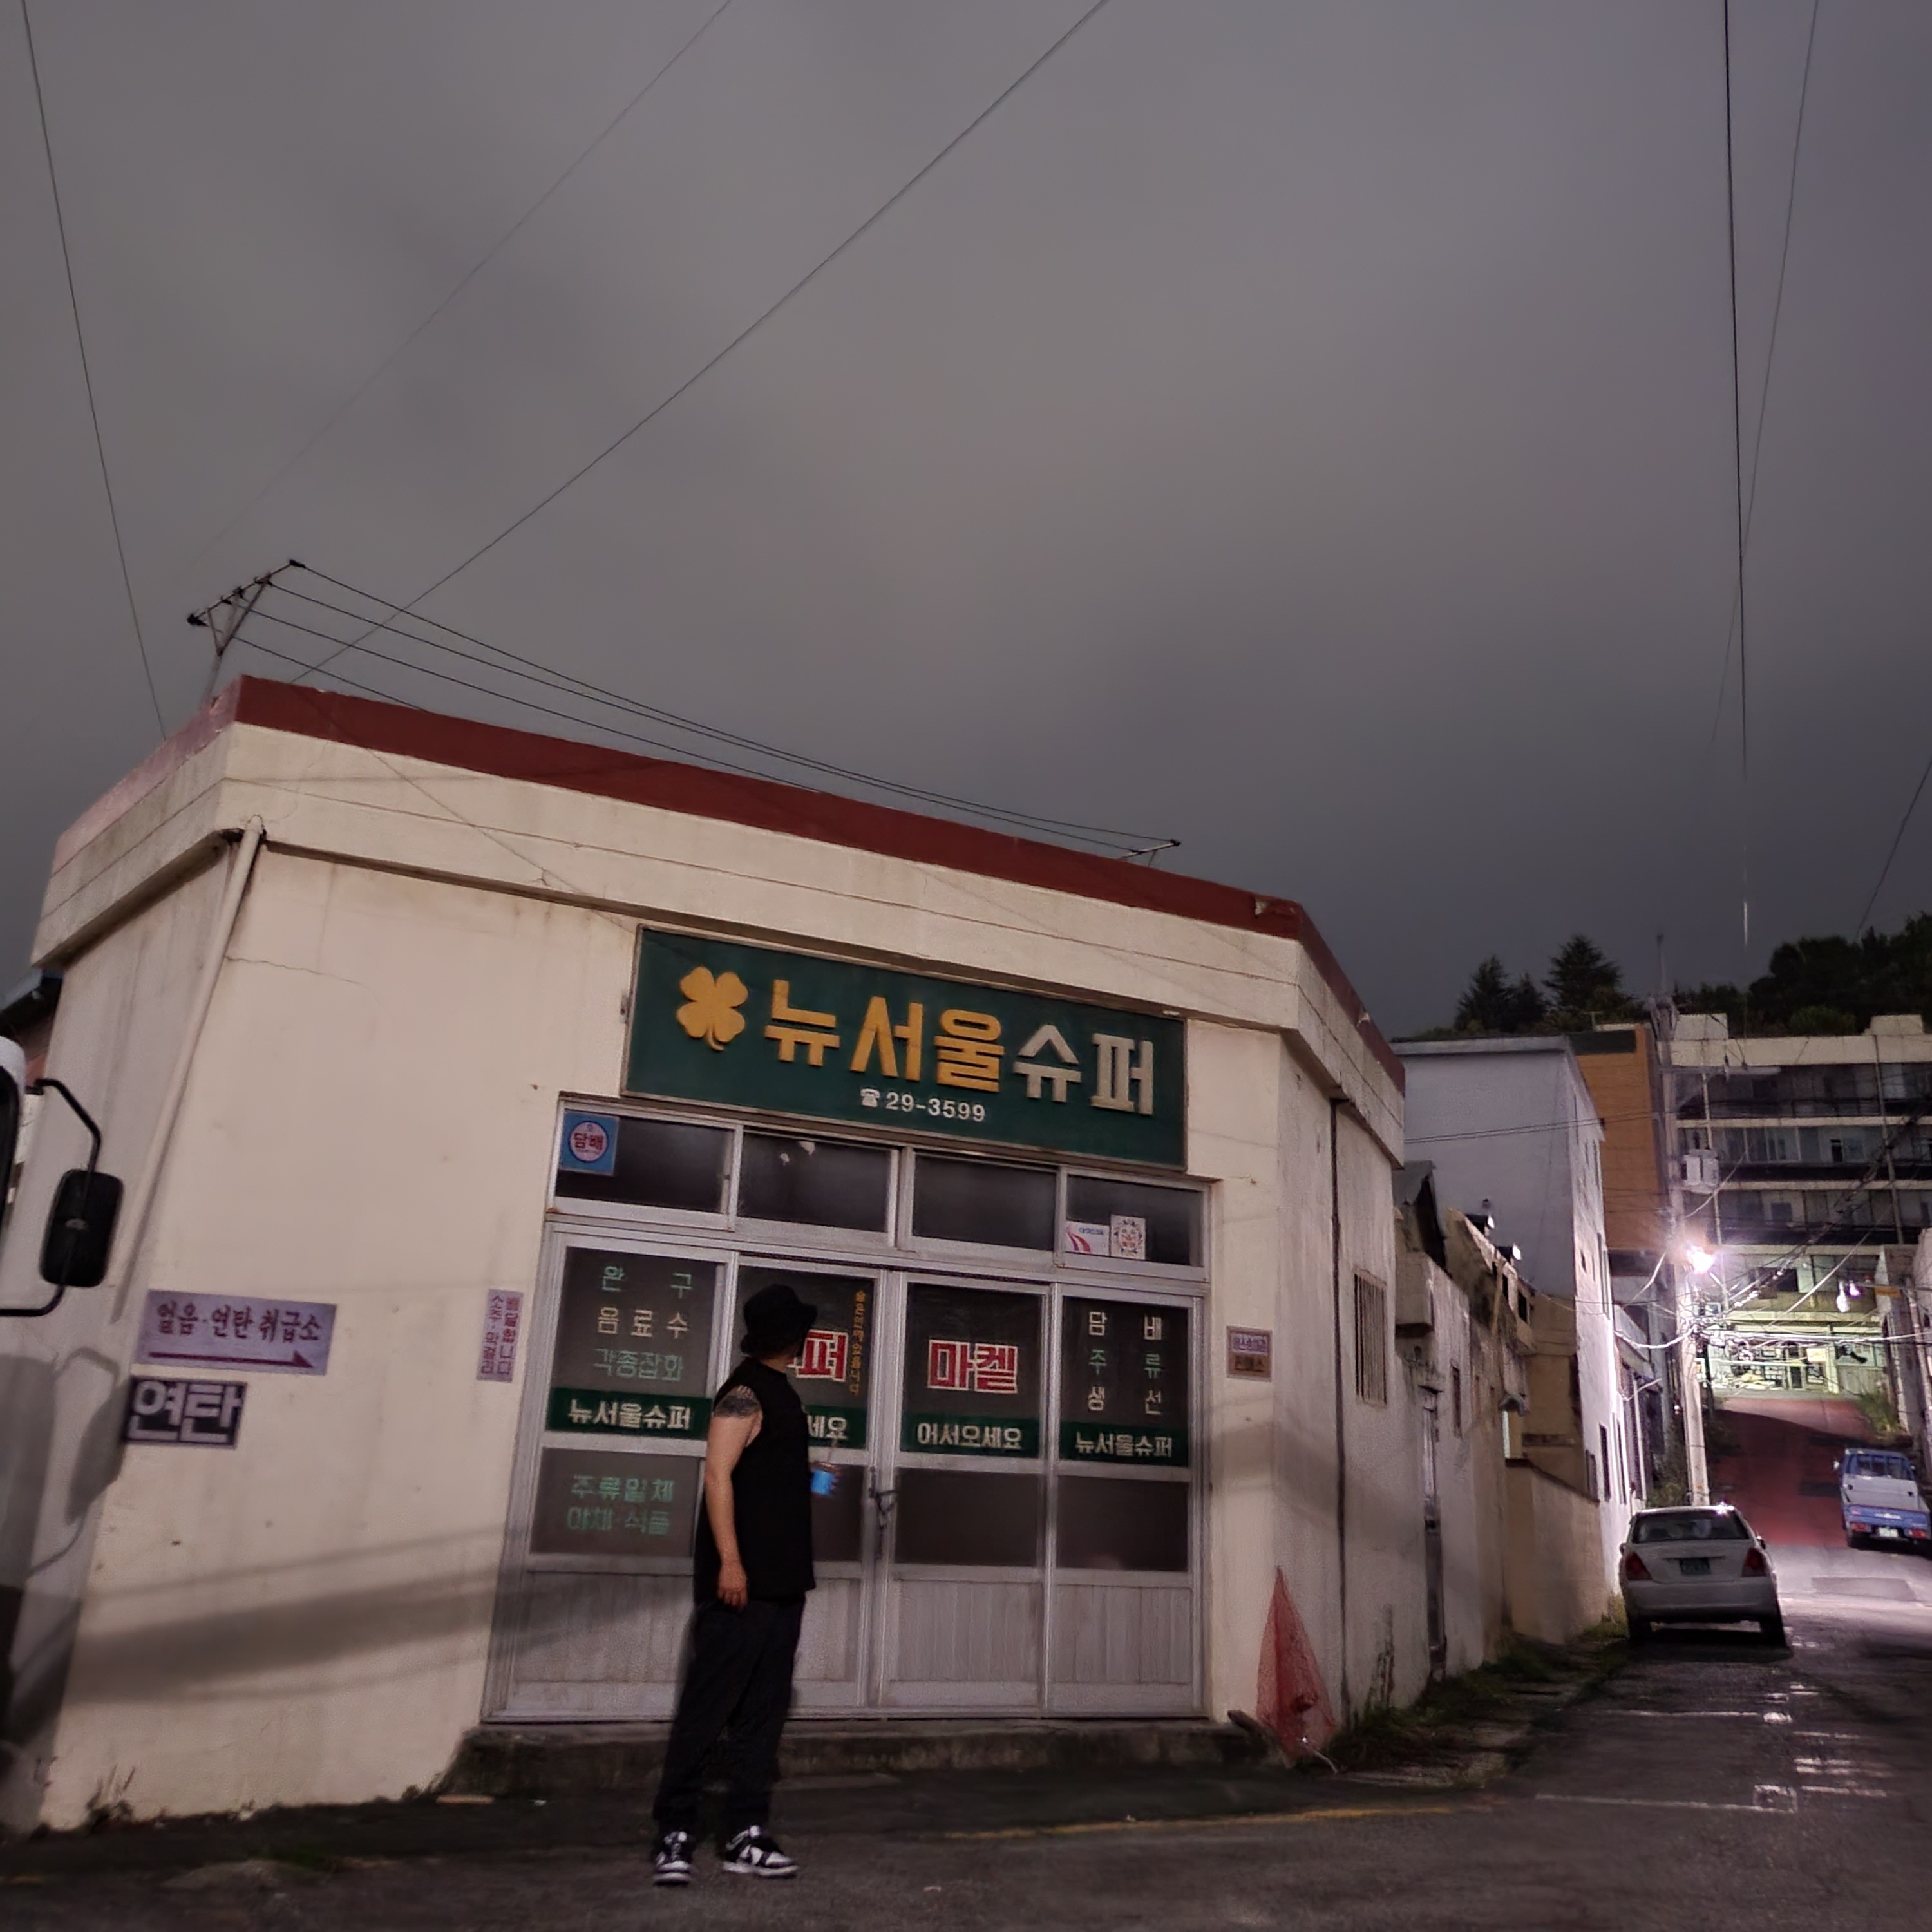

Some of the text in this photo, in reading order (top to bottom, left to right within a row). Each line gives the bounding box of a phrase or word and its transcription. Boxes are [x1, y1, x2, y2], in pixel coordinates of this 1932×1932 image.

[764, 978, 1155, 1115] 뉴서울슈퍼
[886, 1092, 986, 1122] 29-3599
[259, 1308, 321, 1343] 취급소
[787, 1329, 848, 1382] 퍼
[126, 1379, 242, 1443] 연탄
[569, 1399, 692, 1430] 뉴서울슈퍼
[917, 1421, 1023, 1450] 어서오세요
[1075, 1432, 1173, 1457] 뉴서울슈퍼
